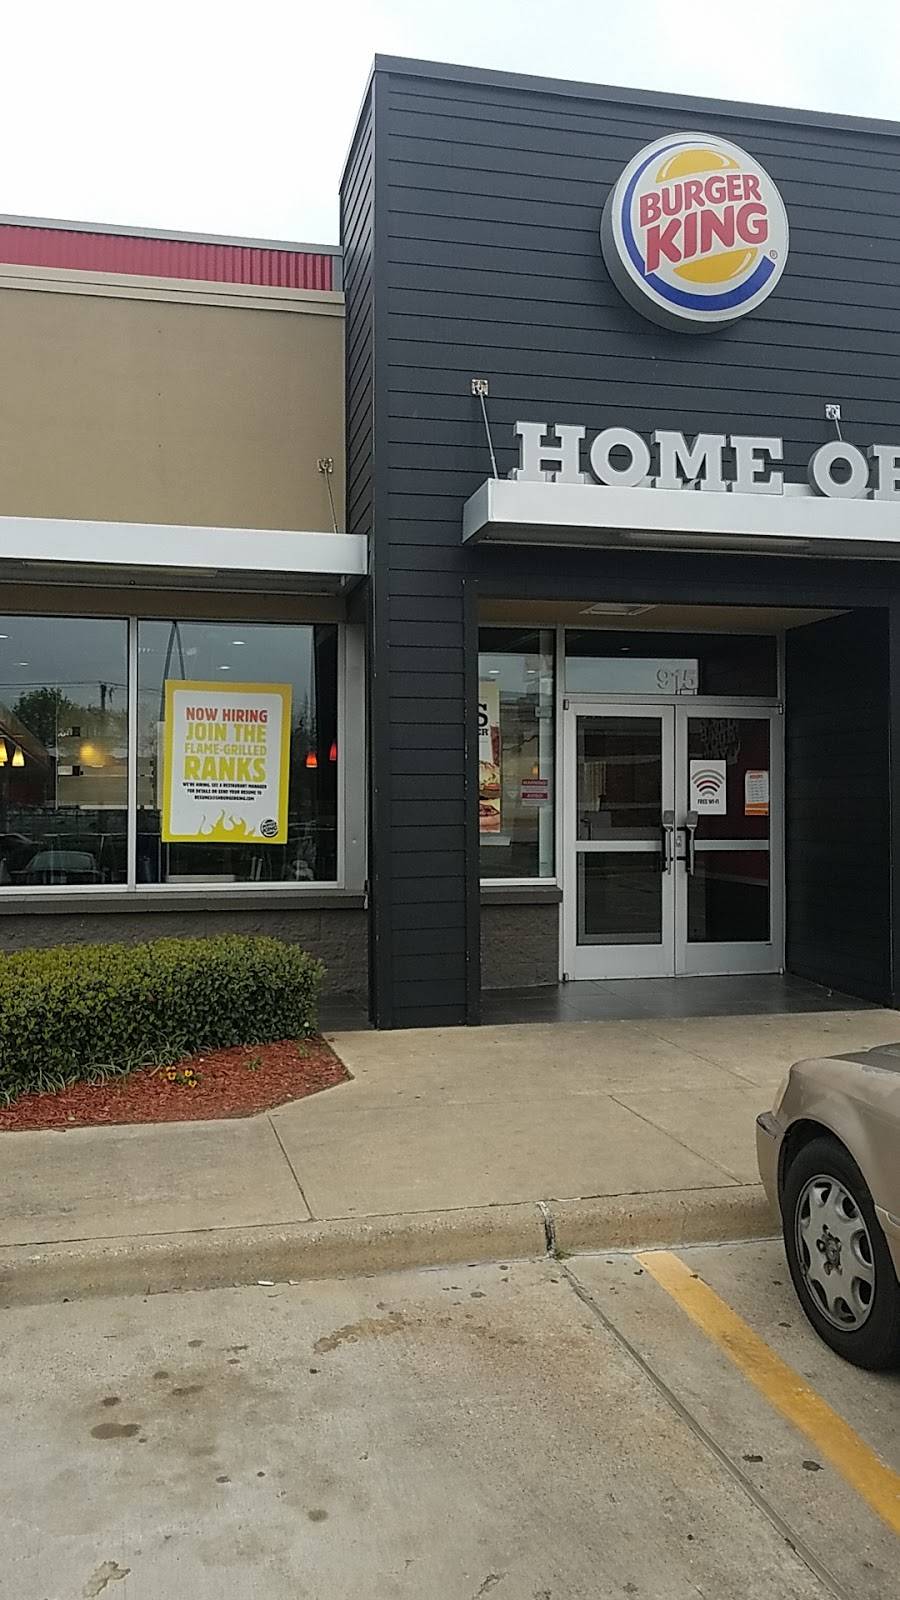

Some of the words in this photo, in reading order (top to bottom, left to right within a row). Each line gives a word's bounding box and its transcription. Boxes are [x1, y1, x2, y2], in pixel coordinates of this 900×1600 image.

[639, 174, 762, 227] BURGER
[646, 202, 769, 273] KING
[513, 420, 784, 496] HOME
[656, 669, 694, 690] 915
[186, 707, 218, 721] NOW
[222, 708, 268, 723] HIRING
[185, 722, 227, 741] JOIN
[234, 723, 267, 743] THE
[184, 742, 267, 756] FLAME-GRILLED
[183, 755, 266, 783] RANKS
